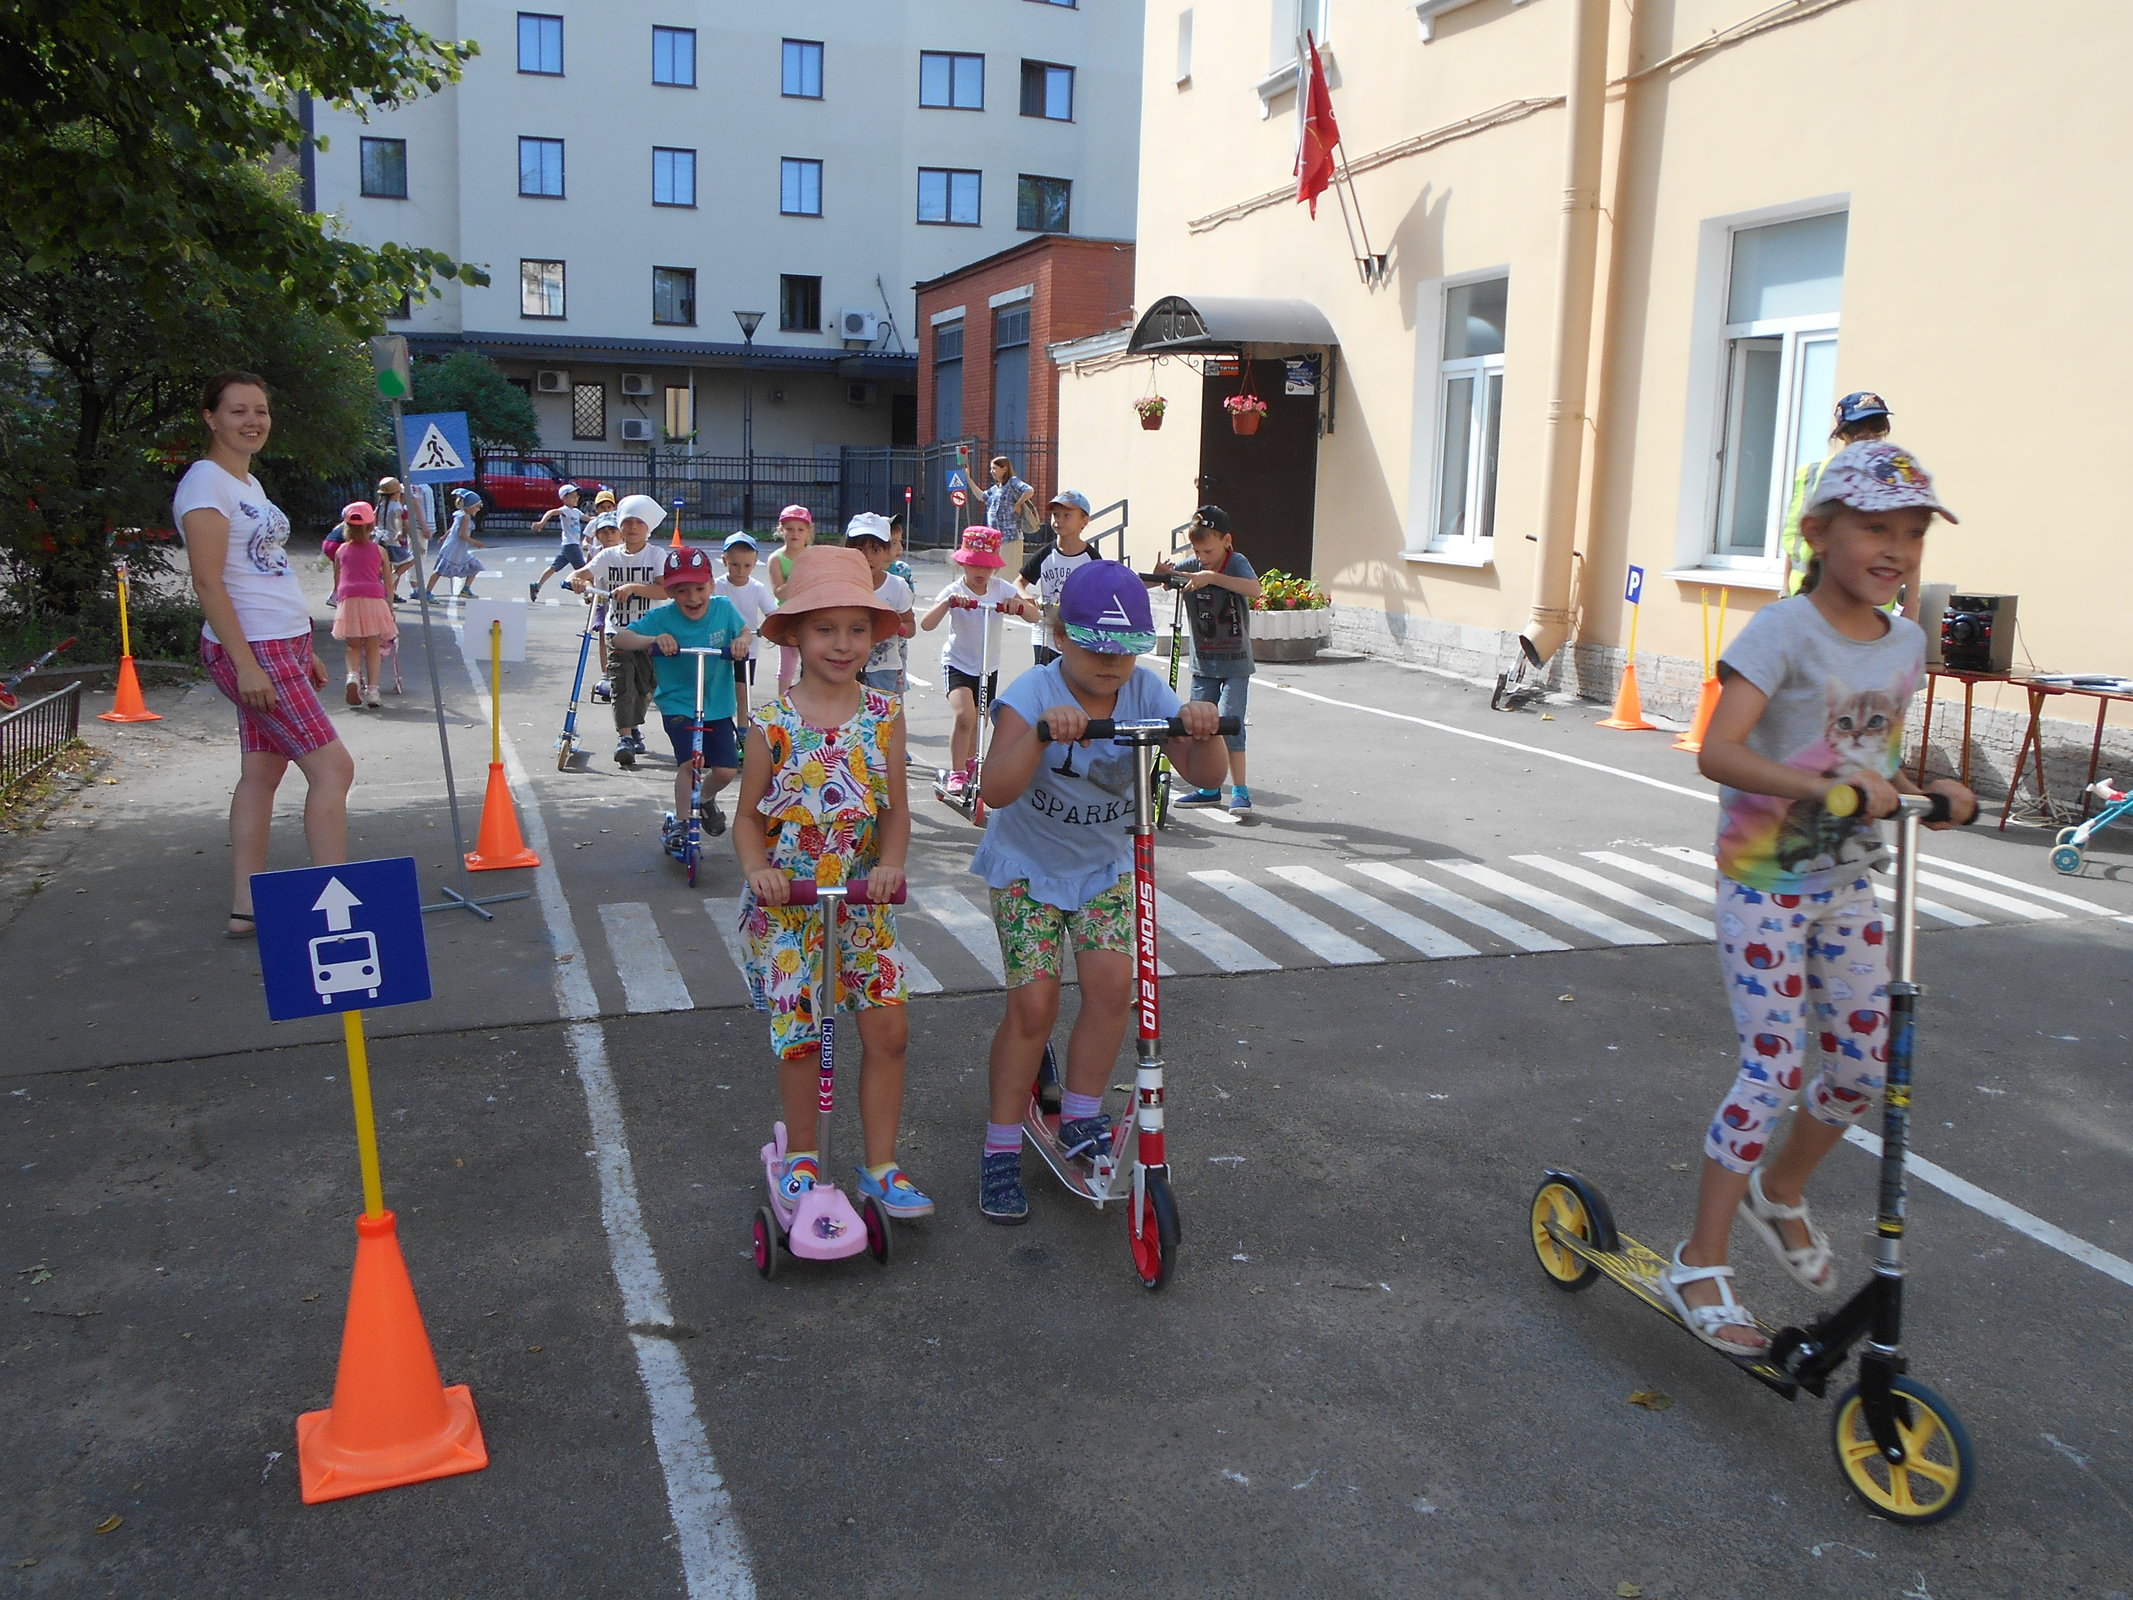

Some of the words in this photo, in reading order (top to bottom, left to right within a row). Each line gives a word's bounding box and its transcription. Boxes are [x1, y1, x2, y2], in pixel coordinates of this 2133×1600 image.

[1628, 570, 1641, 597] P
[1169, 647, 1181, 689] SPORT
[1138, 880, 1155, 976] SPORT
[1141, 978, 1156, 1031] 210
[821, 1023, 834, 1069] ACTION
